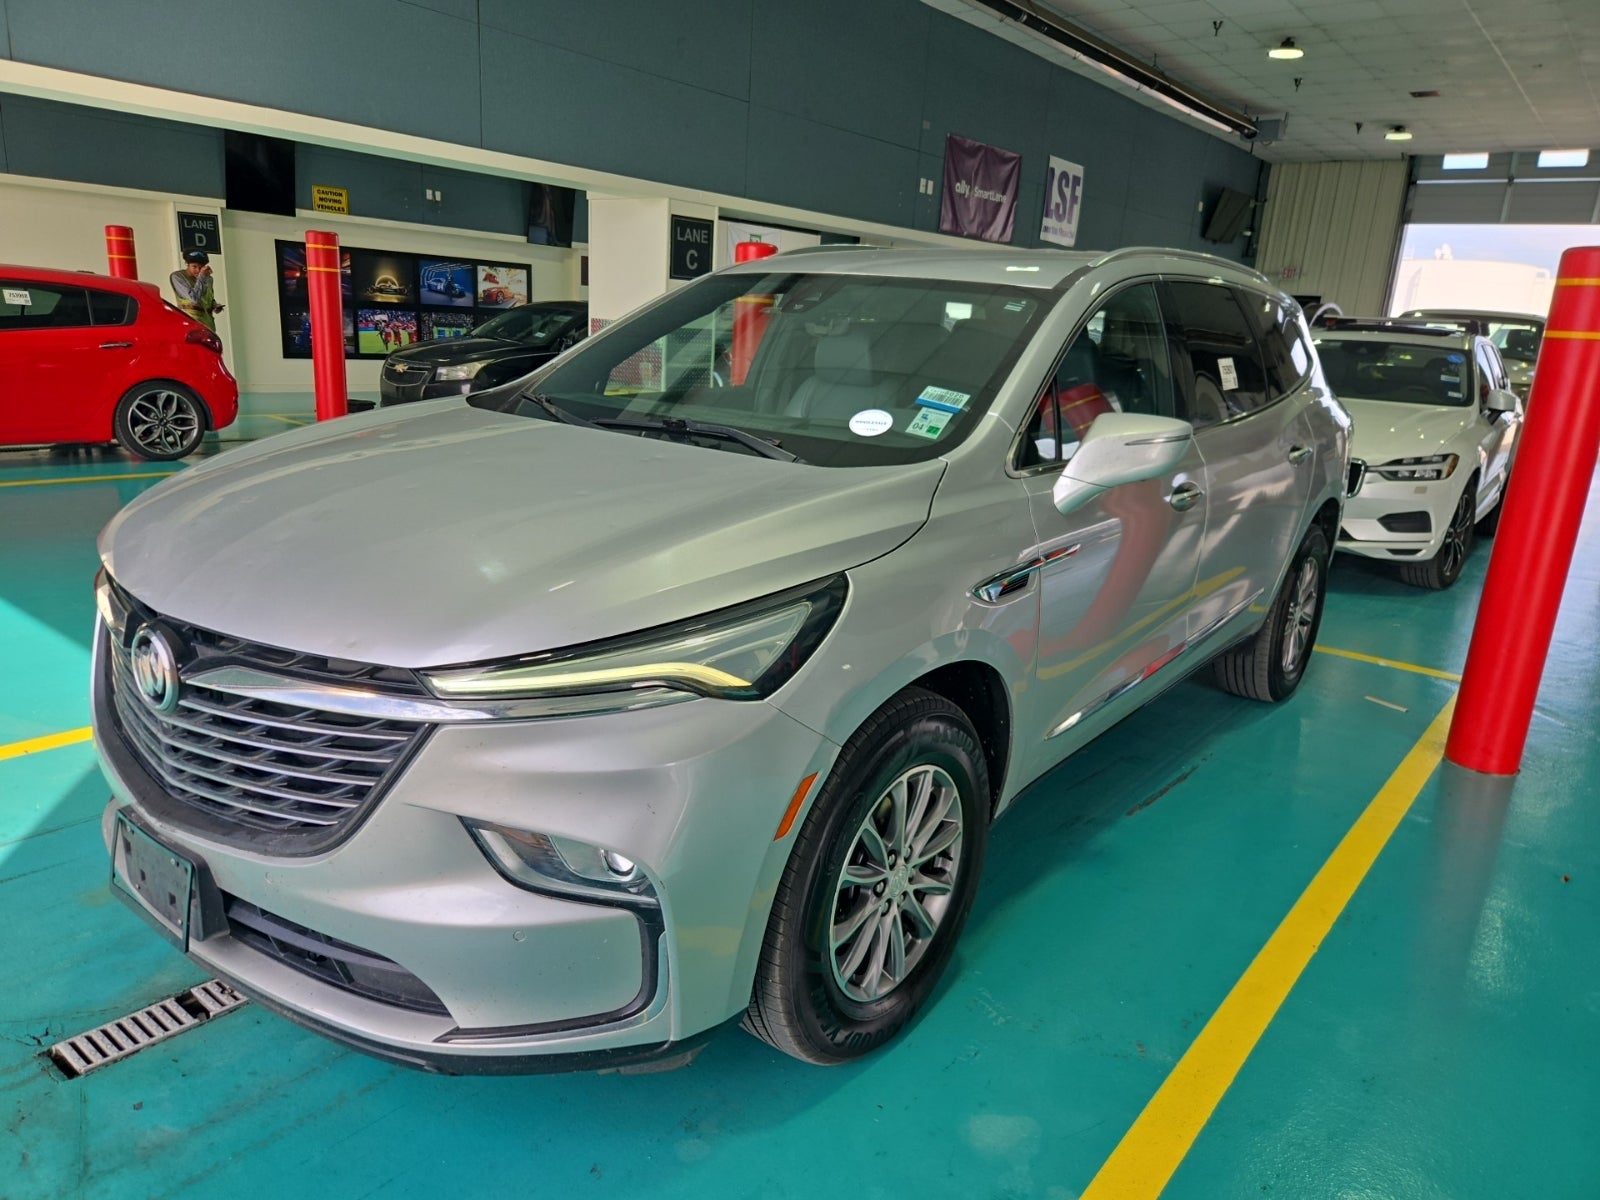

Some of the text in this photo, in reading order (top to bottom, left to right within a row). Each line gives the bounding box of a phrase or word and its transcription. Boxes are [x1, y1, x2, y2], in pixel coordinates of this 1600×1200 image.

[316, 189, 343, 197] CAUTION
[955, 179, 971, 199] ally
[1044, 166, 1081, 224] LSF
[318, 196, 342, 204] MOVING
[317, 203, 345, 212] VEHICLES
[183, 218, 215, 230] LANE
[194, 232, 207, 247] D
[676, 226, 709, 244] LANE
[686, 249, 698, 270] C
[912, 421, 924, 431] 04
